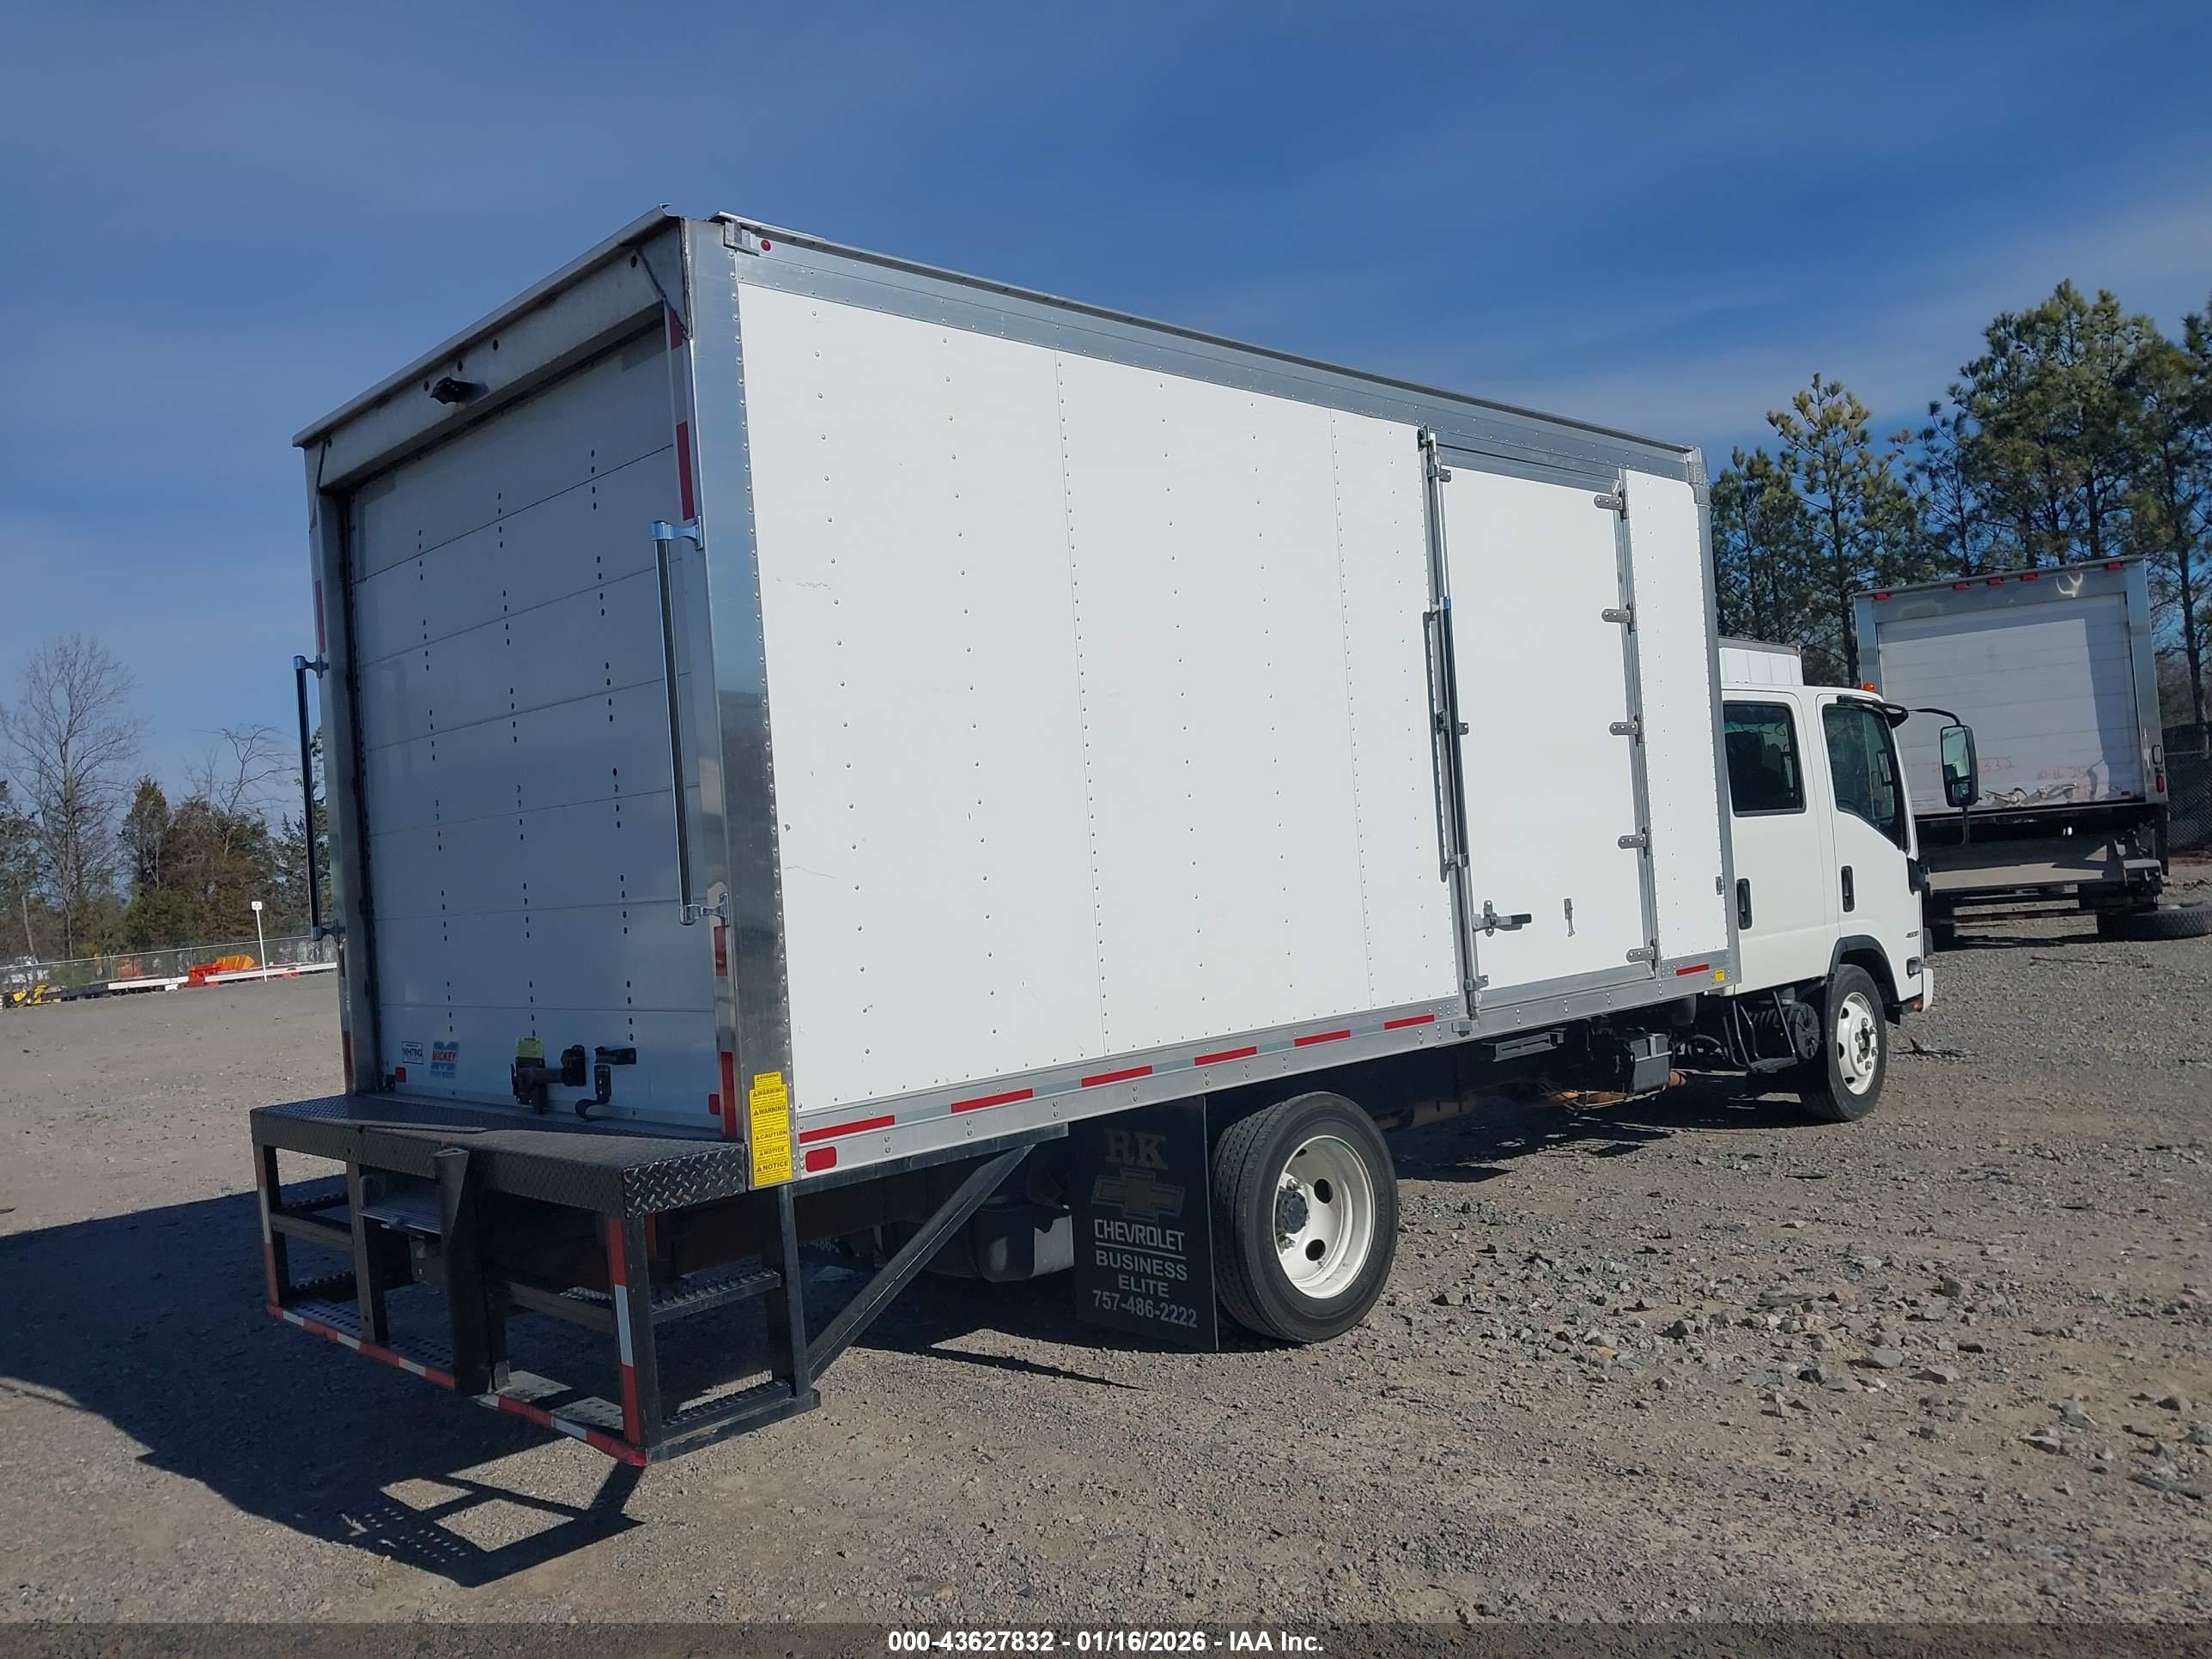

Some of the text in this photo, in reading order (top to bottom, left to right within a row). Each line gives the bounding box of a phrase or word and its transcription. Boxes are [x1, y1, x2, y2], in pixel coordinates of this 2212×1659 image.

[432, 1050, 458, 1061] MICKEY
[758, 1086, 785, 1096] WARNING
[759, 1104, 787, 1115] WARNING
[760, 1130, 787, 1139] CAUTION
[764, 1146, 785, 1155] NOTICE
[763, 1160, 789, 1170] NOTICE
[1094, 1218, 1185, 1252] CHEVROLET
[1096, 1249, 1188, 1281] BUSINESS
[1118, 1273, 1170, 1297] ELITE
[1092, 1289, 1198, 1328] 757-486-2222
